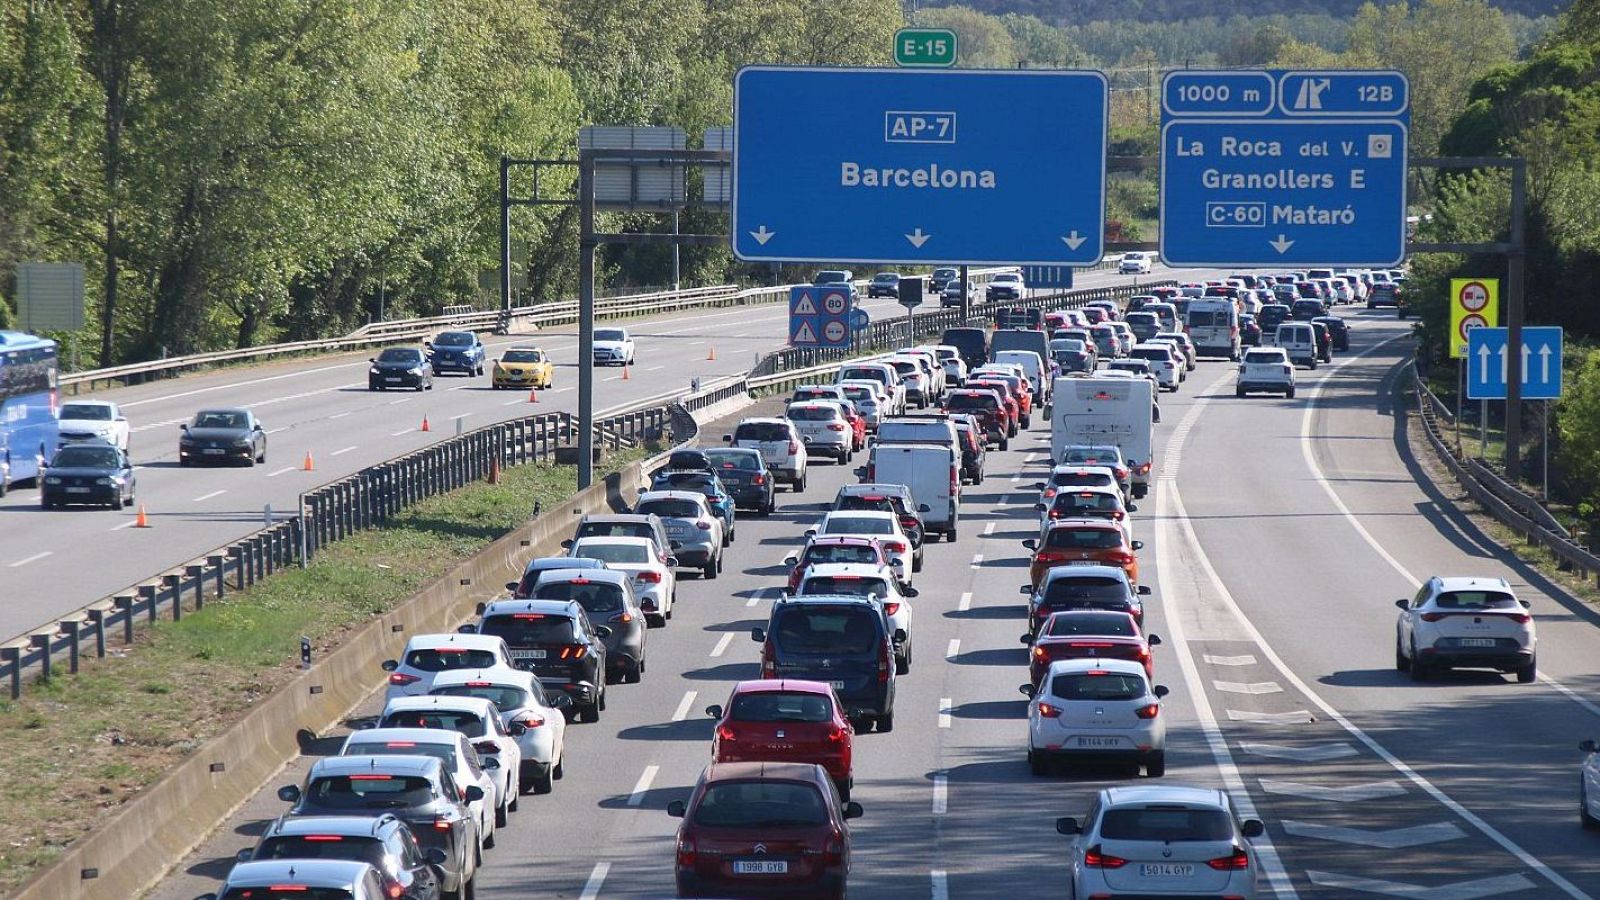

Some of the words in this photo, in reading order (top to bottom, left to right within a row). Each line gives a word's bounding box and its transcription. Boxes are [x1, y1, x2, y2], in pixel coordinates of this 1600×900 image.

[903, 40, 947, 57] E-15
[1178, 85, 1230, 102] 1000
[1243, 88, 1260, 102] m
[1358, 86, 1394, 102] 12B
[891, 117, 950, 137] AP-7
[1177, 137, 1204, 156] La
[1221, 137, 1282, 156] Roca
[1299, 142, 1328, 156] del
[1341, 142, 1359, 156] V.
[841, 162, 996, 190] Barcelona
[1202, 169, 1334, 189] Granollers
[1350, 170, 1366, 189] E
[1211, 206, 1262, 223] C-60
[1272, 204, 1355, 224] Mataró
[828, 300, 842, 308] 80
[741, 863, 763, 872] 1998
[1146, 864, 1171, 875] 5014
